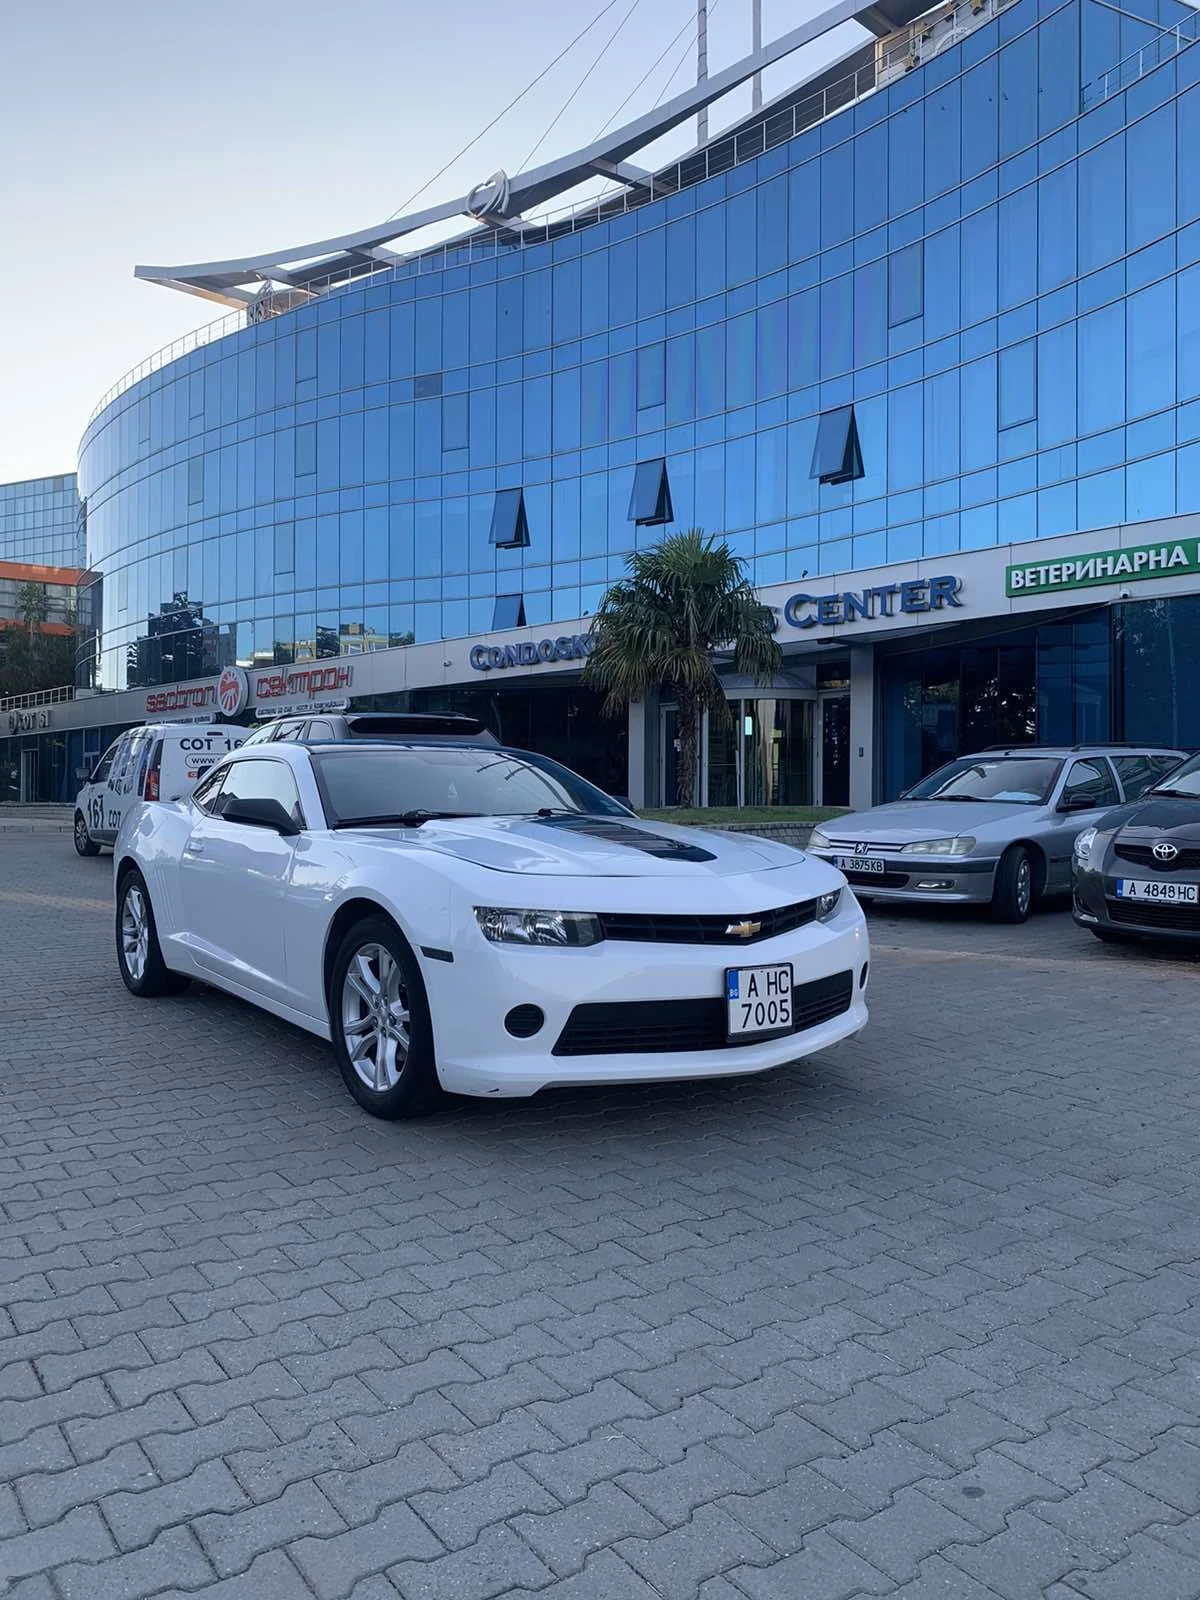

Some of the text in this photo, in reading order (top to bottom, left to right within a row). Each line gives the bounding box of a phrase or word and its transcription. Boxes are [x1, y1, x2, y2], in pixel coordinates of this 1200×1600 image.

[1011, 545, 1189, 589] ВЕТЕРИНАРНА
[784, 575, 962, 628] CENTER
[224, 738, 244, 751] 16
[1129, 882, 1136, 895] A
[1144, 884, 1175, 898] 4848
[748, 970, 789, 997] A HC
[741, 999, 789, 1029] 7005
